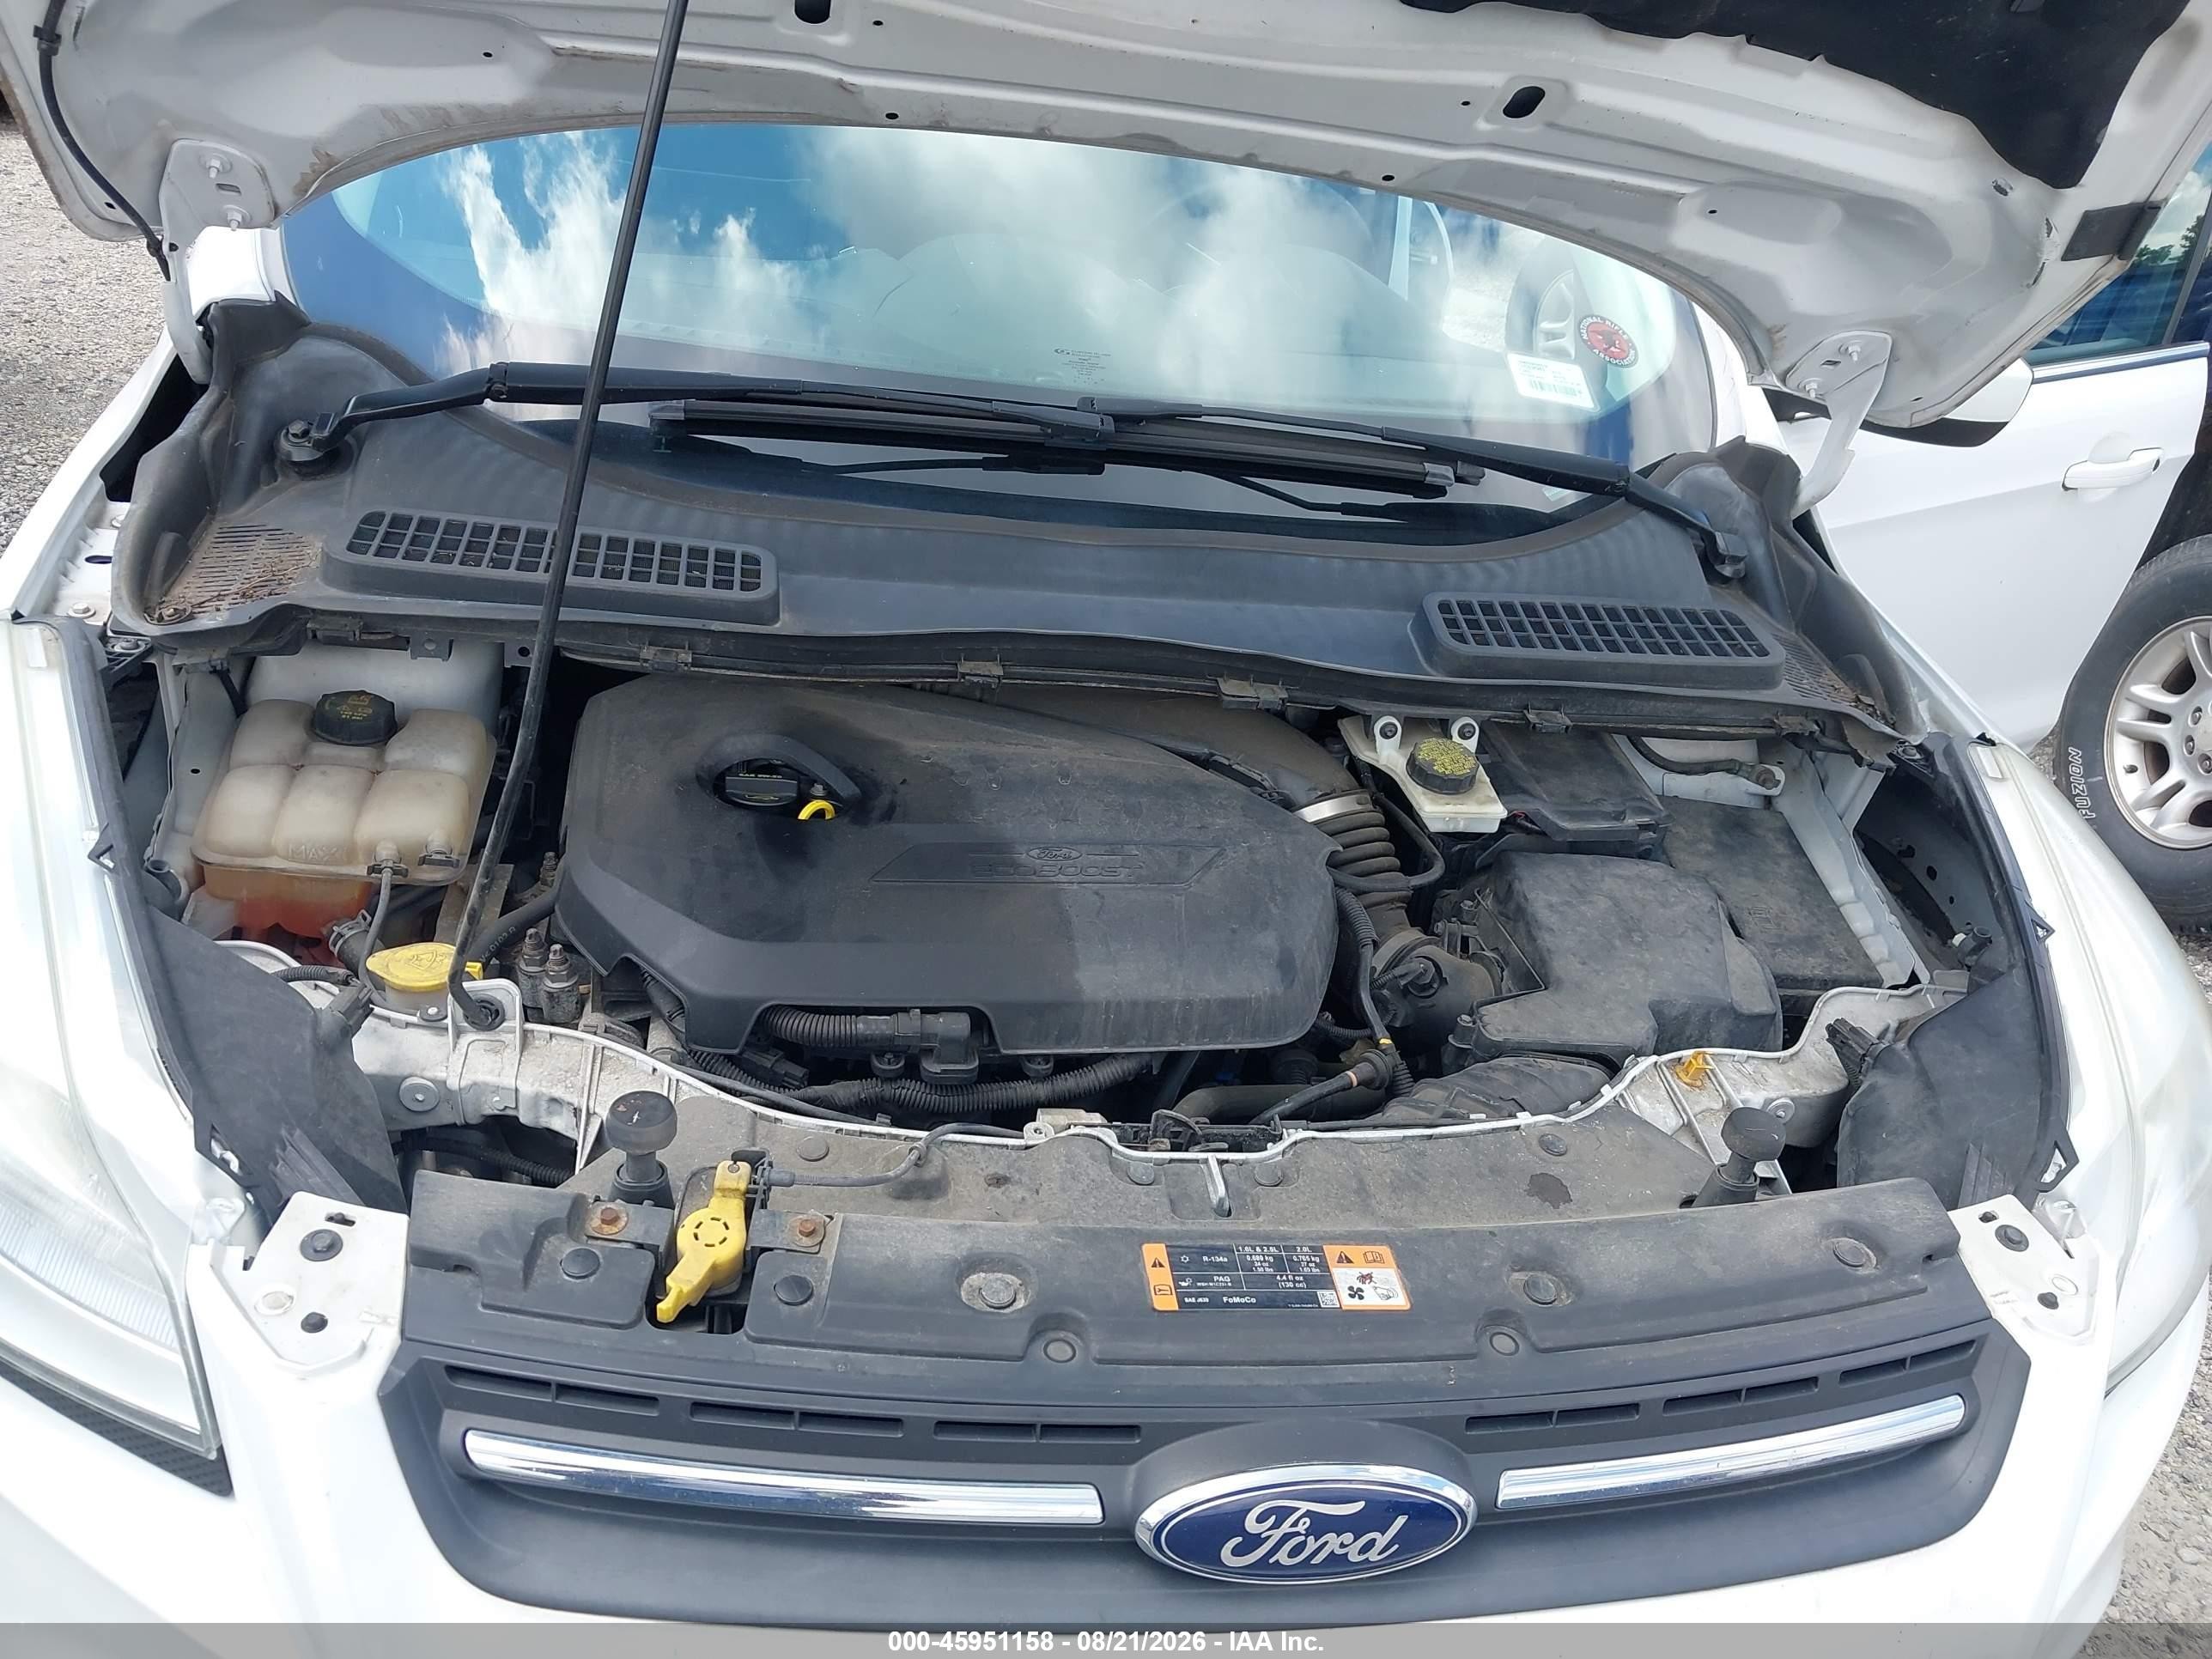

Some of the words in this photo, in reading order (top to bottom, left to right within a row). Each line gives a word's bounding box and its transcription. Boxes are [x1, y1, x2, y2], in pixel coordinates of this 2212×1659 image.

[1580, 316, 1604, 340] NATIONAL
[1605, 319, 1629, 340] RIFLE
[1593, 349, 1635, 366] ASSOCIATION
[2069, 746, 2096, 818] FUZION
[289, 843, 337, 861] MAX
[1037, 848, 1073, 859] Ford
[1220, 1500, 1409, 1567] Ford
